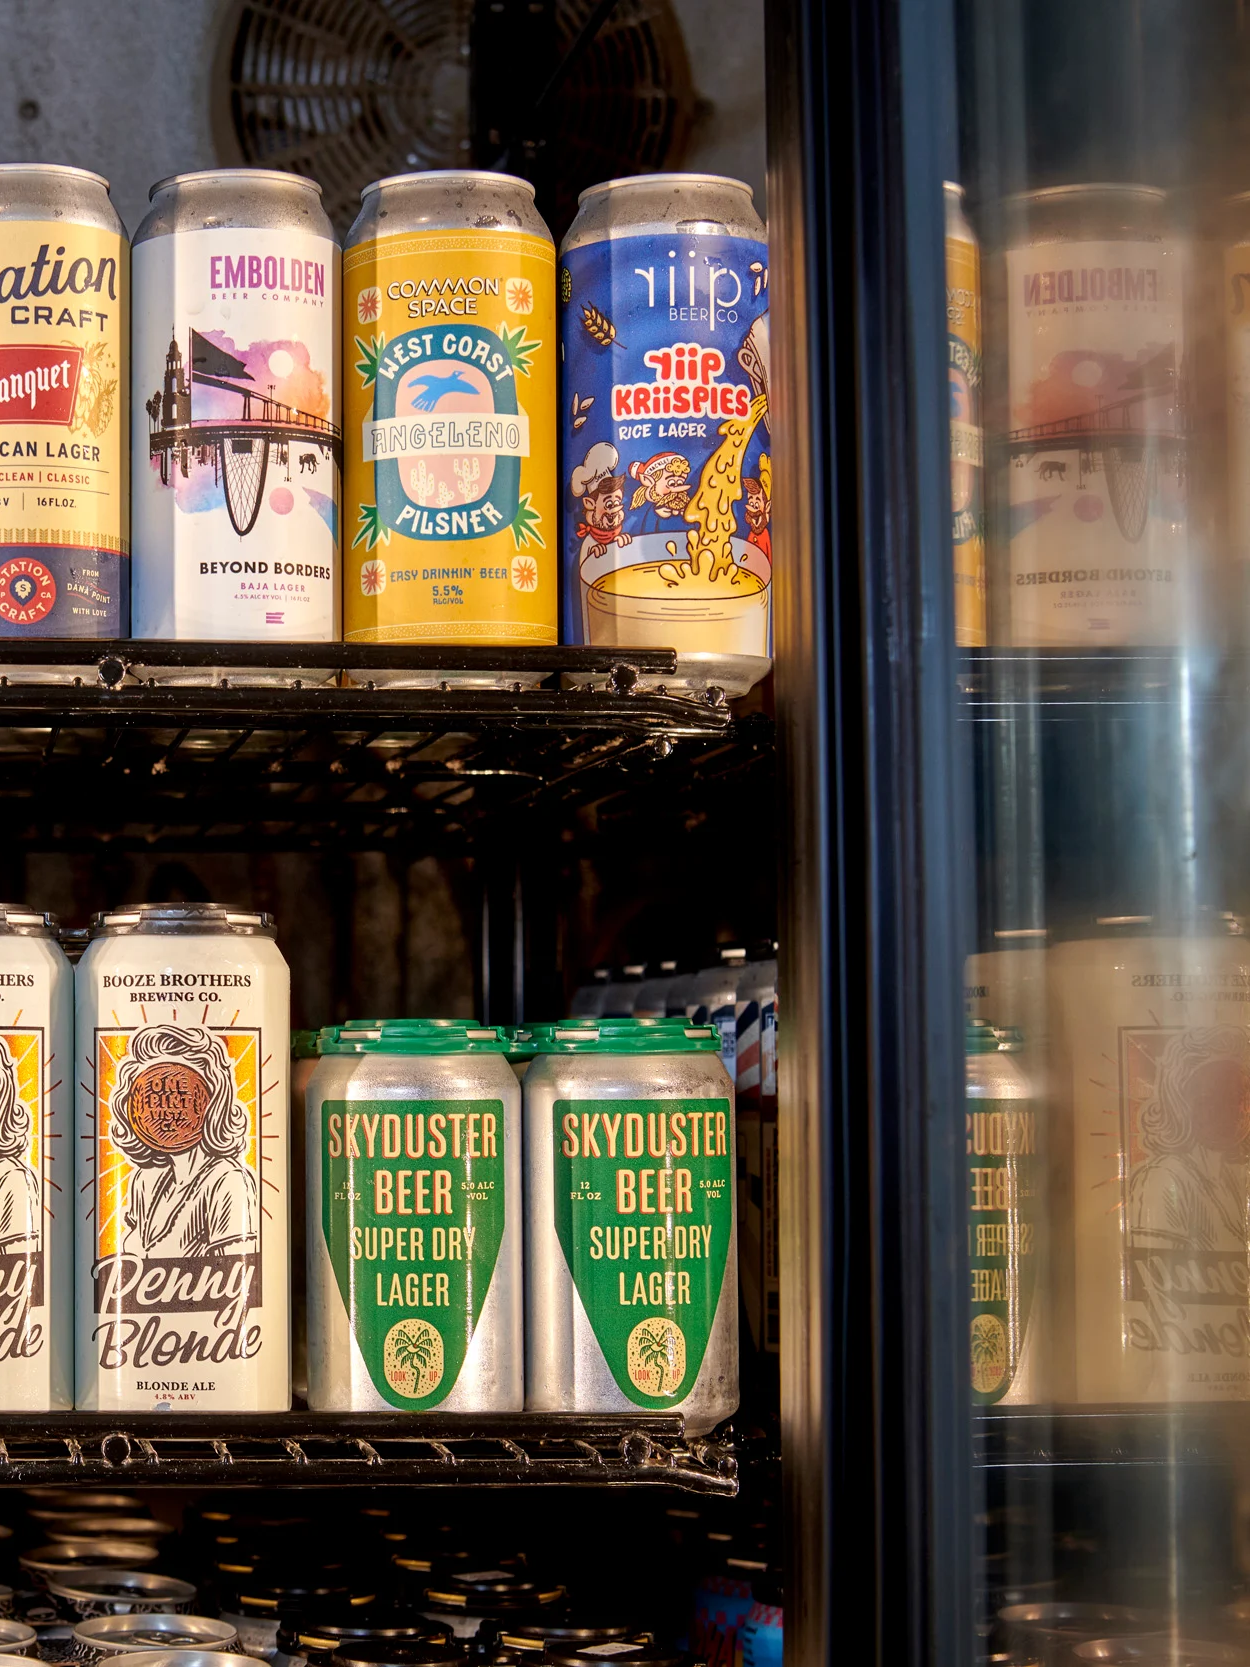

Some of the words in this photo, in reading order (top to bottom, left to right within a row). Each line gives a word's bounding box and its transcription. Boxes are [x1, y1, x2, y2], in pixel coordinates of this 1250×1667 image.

[210, 255, 325, 297] EMBOLDEN
[387, 277, 500, 300] COMMON
[261, 293, 325, 308] COMPANY
[408, 297, 479, 318] SPACE
[10, 306, 108, 332] CRAFT
[669, 307, 708, 321] BEER
[716, 309, 739, 323] CO
[378, 333, 434, 381] WEST
[442, 333, 513, 381] COAST
[371, 422, 520, 455] ANGELENO
[619, 424, 652, 440] RICE
[658, 422, 707, 438] LAGER
[46, 442, 100, 462] LAGER
[47, 473, 90, 485] CLASSIC
[395, 501, 503, 535] PILSNER
[82, 569, 99, 577] FROM
[200, 561, 268, 575] BEYOND
[274, 562, 331, 580] BORDERS
[390, 570, 419, 582] EASY
[423, 568, 475, 580] DRINKIN'
[480, 568, 507, 579] BEER
[41, 591, 52, 599] CA
[67, 583, 90, 596] DANA
[91, 591, 111, 604] POINT
[240, 582, 269, 590] BAJA
[274, 583, 306, 593] LAGER
[432, 585, 463, 597] 5.5%
[0, 602, 47, 621] CRAFT
[72, 607, 91, 616] WITH
[92, 608, 107, 617] LOVE
[103, 974, 155, 988] BOOZE
[160, 974, 251, 988] BROTHERS
[130, 992, 194, 1002] BREWING
[199, 992, 222, 1002] CO.
[152, 1076, 190, 1094] ONE
[150, 1093, 193, 1109] PINT
[150, 1110, 188, 1121] VISTA
[328, 1113, 497, 1159] SKYDUSTER
[562, 1111, 727, 1158] SKYDUSTER
[374, 1170, 453, 1215] BEER
[477, 1181, 494, 1190] ALC
[580, 1182, 590, 1190] 12
[616, 1169, 693, 1214] BEER
[700, 1180, 712, 1189] 5.0
[713, 1179, 725, 1188] ALC
[334, 1192, 346, 1200] FL
[469, 1192, 488, 1200] VOL
[570, 1192, 584, 1200] FL
[587, 1192, 601, 1200] OZ
[706, 1190, 721, 1199] VOL
[351, 1227, 425, 1261] SUPER
[432, 1227, 476, 1261] DRY
[590, 1226, 667, 1260] SUPER
[675, 1225, 712, 1259] DRY
[91, 1252, 256, 1328] Penny
[376, 1272, 450, 1307] LAGER
[618, 1272, 691, 1306] LAGER
[92, 1315, 262, 1370] Blonde
[390, 1370, 407, 1382] LOOK
[429, 1371, 438, 1382] UP
[634, 1369, 650, 1380] LOOK
[672, 1369, 681, 1380] UP
[137, 1381, 189, 1391] BLONDE
[192, 1381, 216, 1391] ALE
